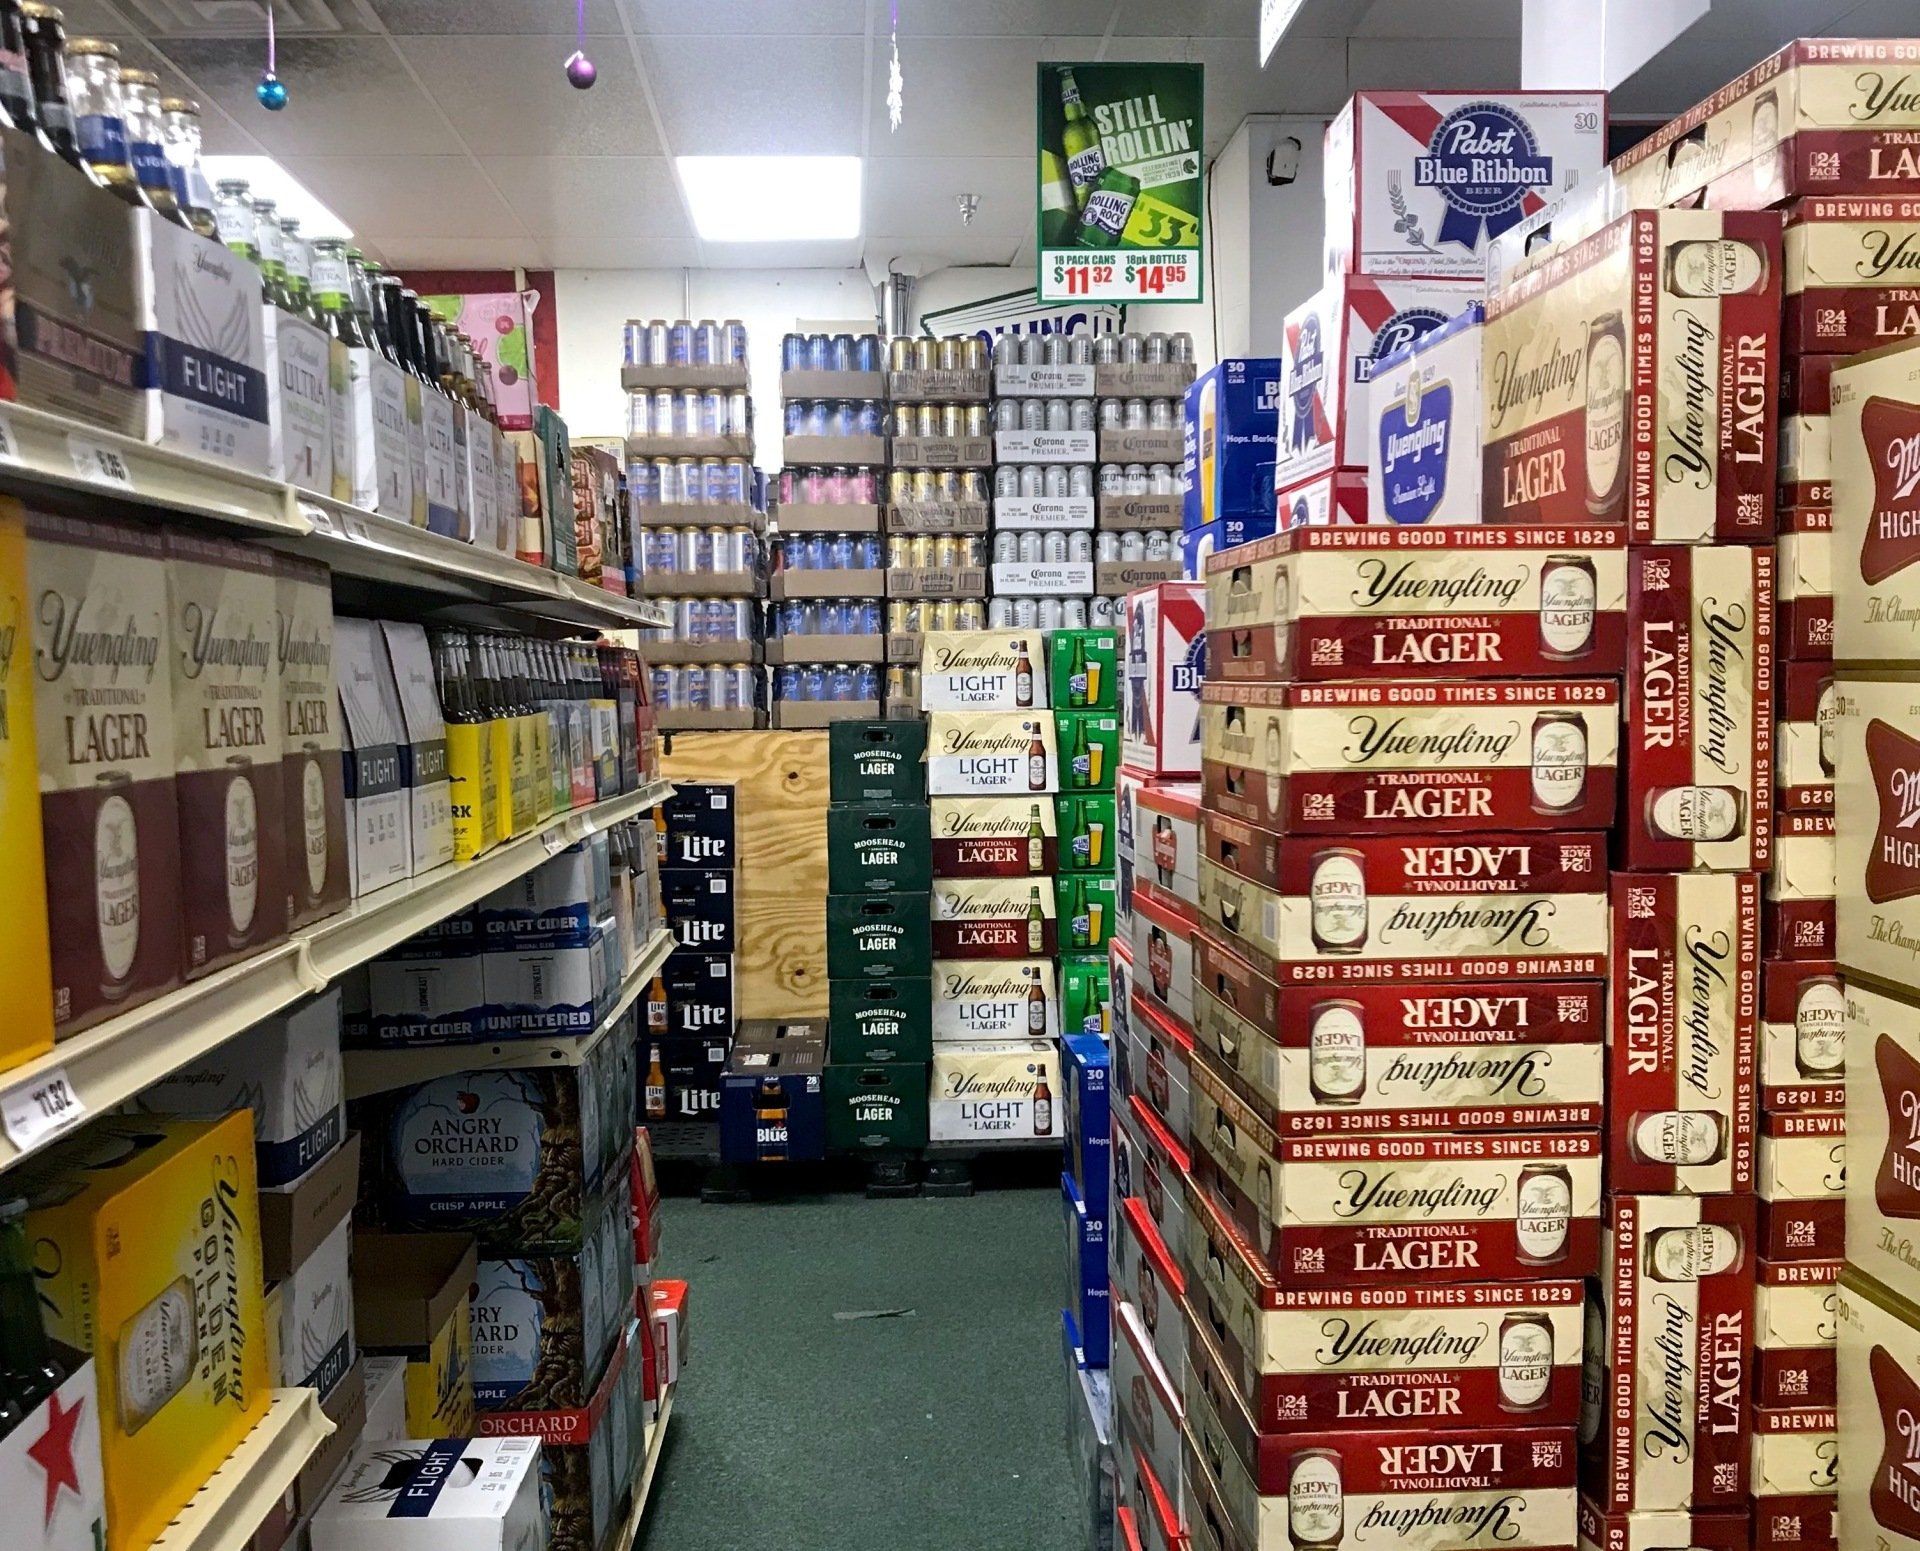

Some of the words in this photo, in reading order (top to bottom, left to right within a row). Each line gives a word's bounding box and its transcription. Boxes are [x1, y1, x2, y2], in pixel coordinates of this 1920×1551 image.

[1808, 45, 1887, 59] BREWING
[1094, 94, 1166, 135] STILL
[1574, 113, 1598, 130] 30
[1616, 136, 1654, 173] BREWING
[1657, 117, 1681, 143] GOOD
[1685, 97, 1714, 126] TIMES
[1718, 75, 1749, 108] SINCE
[1753, 54, 1782, 87] 1829
[1101, 119, 1193, 168] ROLLIN'
[1450, 120, 1515, 155] Pabst
[1067, 151, 1100, 173] ROLLING
[1419, 158, 1468, 184] Blue
[1471, 158, 1548, 184] Ribbon
[1809, 167, 1840, 177] PACK
[1818, 152, 1840, 166] 24
[1465, 187, 1502, 195] BEER
[1090, 193, 1128, 216] ROLLING
[1100, 208, 1122, 228] ROCK
[1640, 220, 1653, 265] 1829
[1054, 255, 1065, 265] 18
[1067, 255, 1090, 265] PACK
[1092, 255, 1116, 265] CANS
[1126, 254, 1148, 266] 18pk
[1149, 254, 1187, 265] BOTTLES
[1722, 243, 1735, 291] LAGER
[1639, 276, 1653, 324] SINCE
[1228, 362, 1245, 372] 30
[1638, 334, 1652, 386] TIMES
[182, 356, 247, 404] FLIGHT
[1490, 321, 1588, 429] Yuengling
[1664, 309, 1715, 489] Yuengling
[1721, 344, 1734, 450] TRADITIONAL
[1735, 333, 1767, 464] LAGER
[1637, 393, 1652, 442] GOOD
[1034, 437, 1064, 447] Corona
[1123, 438, 1168, 450] Corona
[1385, 418, 1446, 473] Yuengling
[1509, 426, 1560, 457] TRADITIONAL
[1503, 449, 1566, 508] LAGER
[1635, 450, 1648, 531] BREWING
[1033, 503, 1064, 514] Corona
[1125, 503, 1170, 515] Corona
[1737, 493, 1751, 517] 24
[1751, 494, 1760, 525] PACK
[1227, 521, 1244, 532] 30
[1309, 532, 1392, 546] BREWING
[1398, 531, 1447, 546] GOOD
[1453, 531, 1507, 545] TIMES
[1514, 531, 1567, 545] SINCE
[1573, 530, 1616, 545] 1829
[1031, 569, 1062, 579] Corona
[1350, 558, 1530, 607] Yuengling
[1758, 557, 1771, 636] BREWING
[1386, 617, 1492, 631] TRADITIONAL
[1543, 611, 1591, 627] LAGER
[37, 589, 160, 684] Yuengling
[182, 602, 271, 681] Yuengling
[1318, 638, 1344, 653] 24
[1372, 633, 1503, 664] LAGER
[934, 647, 1018, 671] Yuengling
[1311, 652, 1342, 664] PACK
[1758, 644, 1770, 691] GOOD
[949, 675, 1007, 691] LIGHT
[1644, 620, 1674, 750] LAGER
[1699, 597, 1746, 774] Yuengling
[73, 688, 141, 706] TRADITIONAL
[961, 692, 995, 702] LAGER
[203, 707, 265, 749] LAGER
[286, 698, 329, 736] LAGER
[1757, 699, 1769, 751] TIMES
[65, 712, 150, 764] LAGER
[943, 729, 1031, 753] Yuengling
[1341, 715, 1521, 764] Yuengling
[416, 749, 444, 777] FLIGHT
[853, 750, 902, 761] MOOSEHEAD
[959, 758, 1019, 775] LIGHT
[362, 758, 395, 786] FLIGHT
[860, 763, 895, 775] LAGER
[971, 775, 1007, 785] LAGER
[1756, 759, 1768, 809] SINCE
[1363, 788, 1495, 819] LAGER
[942, 812, 1029, 837] Yuengling
[681, 835, 725, 862] Lite
[853, 838, 906, 850] MOOSEHEAD
[1755, 819, 1767, 859] 1829
[861, 852, 898, 865] LAGER
[957, 848, 1019, 863] LAGER
[1400, 846, 1531, 877] LAGER
[942, 894, 1028, 918] Yuengling
[486, 919, 533, 933] CRAFT
[537, 916, 578, 930] CIDER
[1380, 900, 1556, 947] Yuengling
[1803, 921, 1825, 935] 24
[957, 929, 1018, 945] LAGER
[1795, 935, 1824, 944] PACK
[943, 974, 1030, 1000] Yuengling
[649, 1002, 666, 1012] Lite
[681, 1004, 726, 1031] Lite
[959, 1003, 1018, 1020] LIGHT
[1628, 948, 1659, 1075] LAGER
[1682, 924, 1730, 1099] Yuengling
[380, 1024, 425, 1038] CRAFT
[430, 1022, 472, 1035] CIDER
[488, 1012, 590, 1029] UNFILTERED
[807, 1076, 817, 1085] 28
[1087, 1069, 1104, 1080] 30
[430, 1118, 502, 1136] ANGRY
[757, 1126, 788, 1143] Blue
[299, 1118, 334, 1166] FLIGHT
[415, 1135, 518, 1154] ORCHARD
[432, 1157, 464, 1166] HARD
[469, 1156, 505, 1166] CIDER
[430, 1201, 465, 1211] CRISP
[469, 1200, 506, 1210] APPLE
[1332, 1169, 1507, 1218] Yuengling
[1353, 1240, 1481, 1271] LAGER
[200, 1198, 229, 1406] GOLDEN
[1315, 1317, 1490, 1366] Yuengling
[1643, 1293, 1694, 1464] Yuengling
[1712, 1310, 1743, 1436] LAGER
[1336, 1389, 1462, 1419] LAGER
[480, 1415, 577, 1434] ORCHARD
[408, 1451, 454, 1497] FLIGHT
